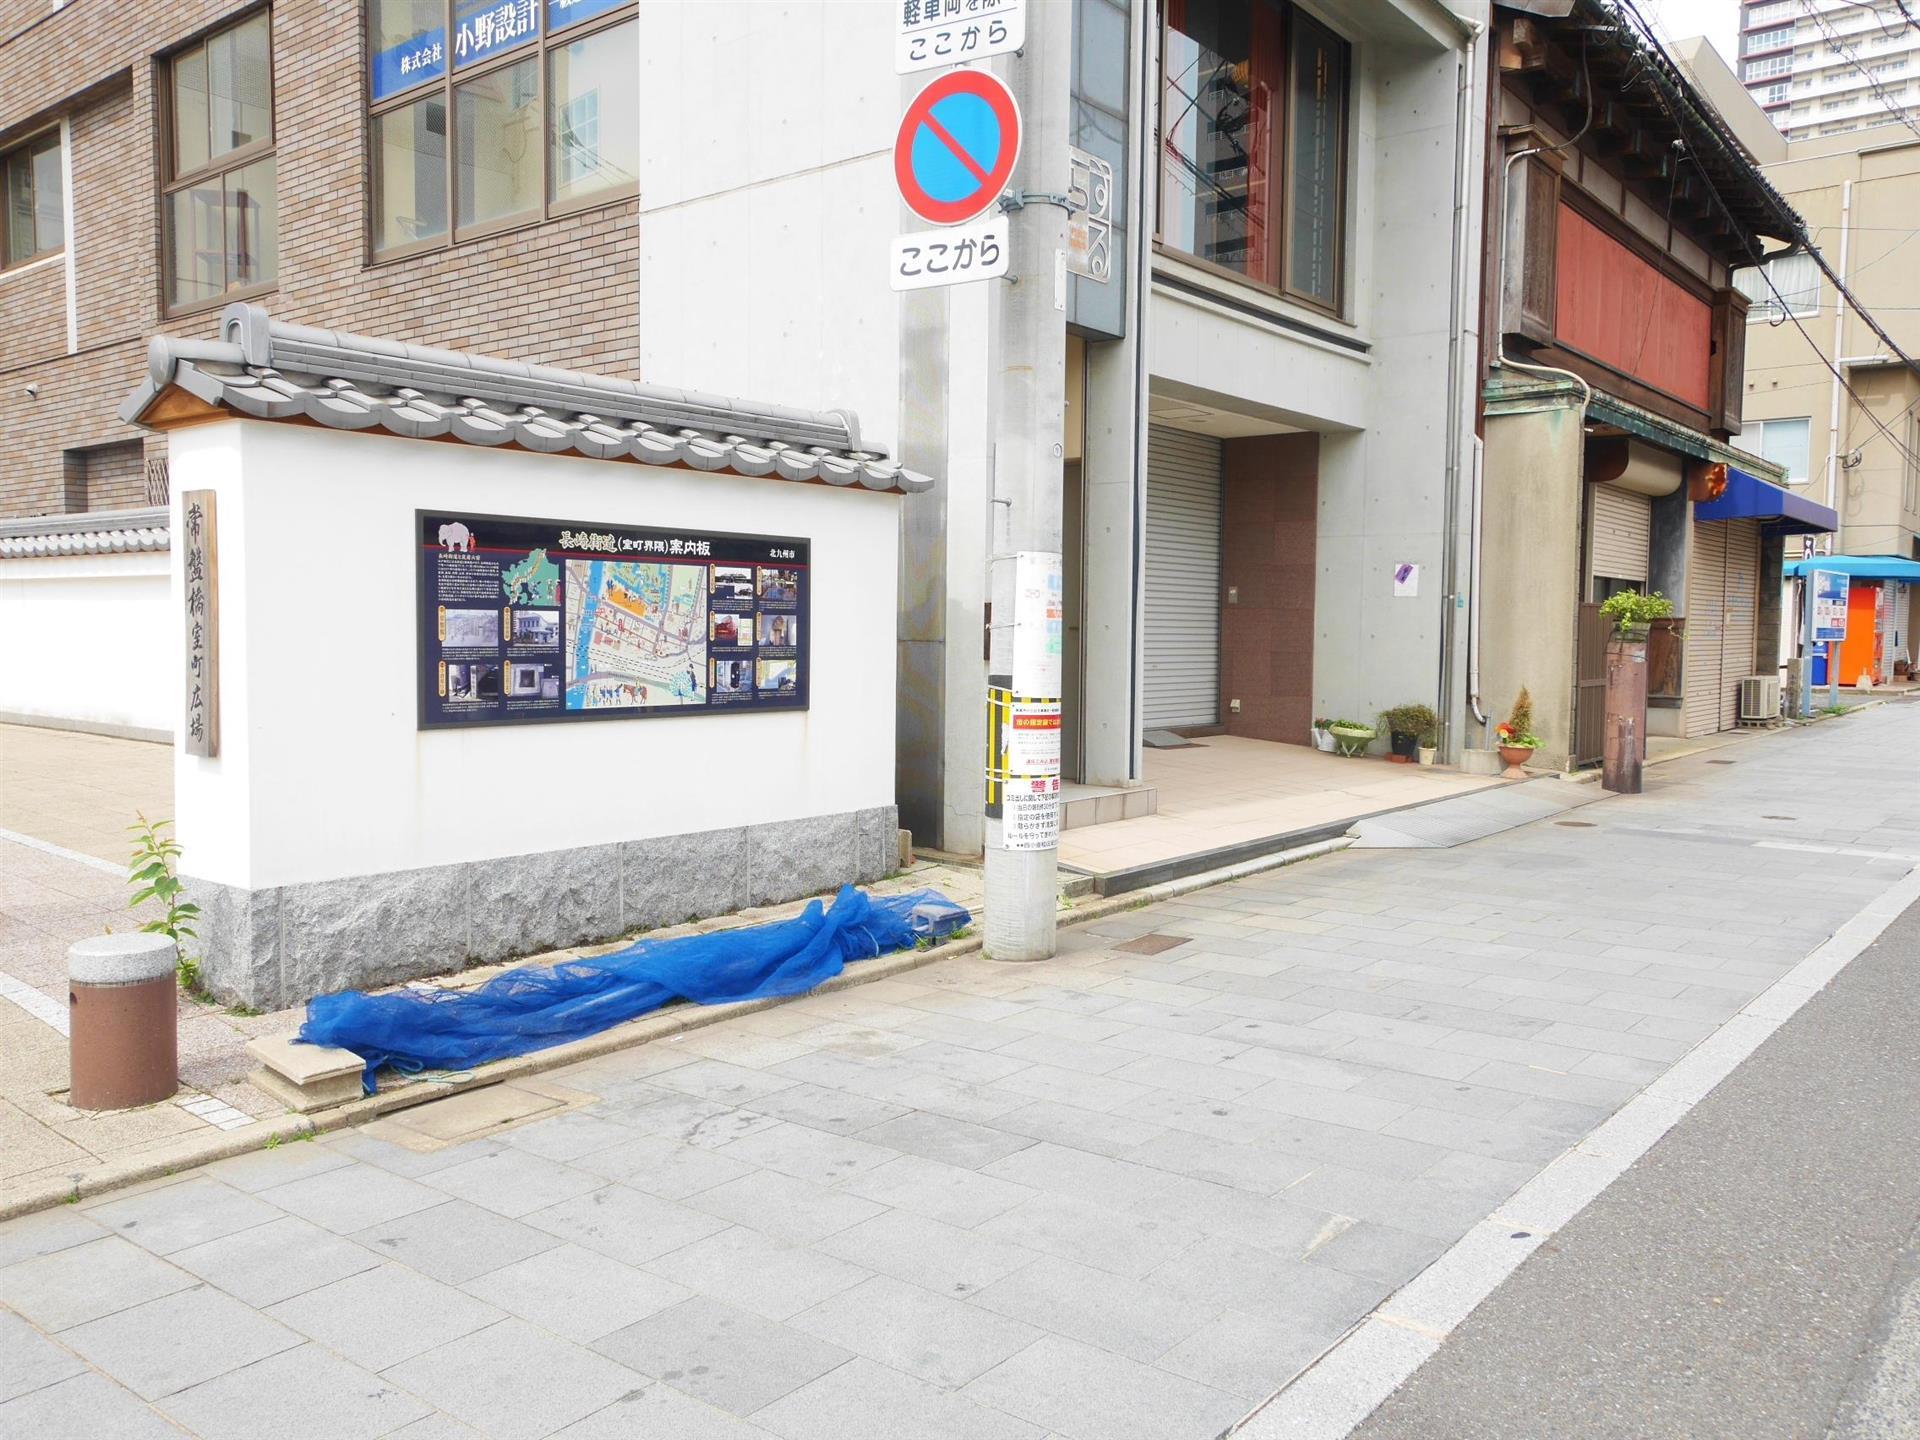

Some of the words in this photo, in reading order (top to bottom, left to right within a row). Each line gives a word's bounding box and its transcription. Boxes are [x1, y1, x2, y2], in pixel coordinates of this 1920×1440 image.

[401, 42, 443, 75] 株式会社
[455, 0, 539, 57] 小野設計
[909, 20, 1007, 60] ここから
[899, 234, 1000, 276] ここから
[769, 548, 796, 560] 北九州市
[186, 503, 205, 744] 常盤橋室町広場
